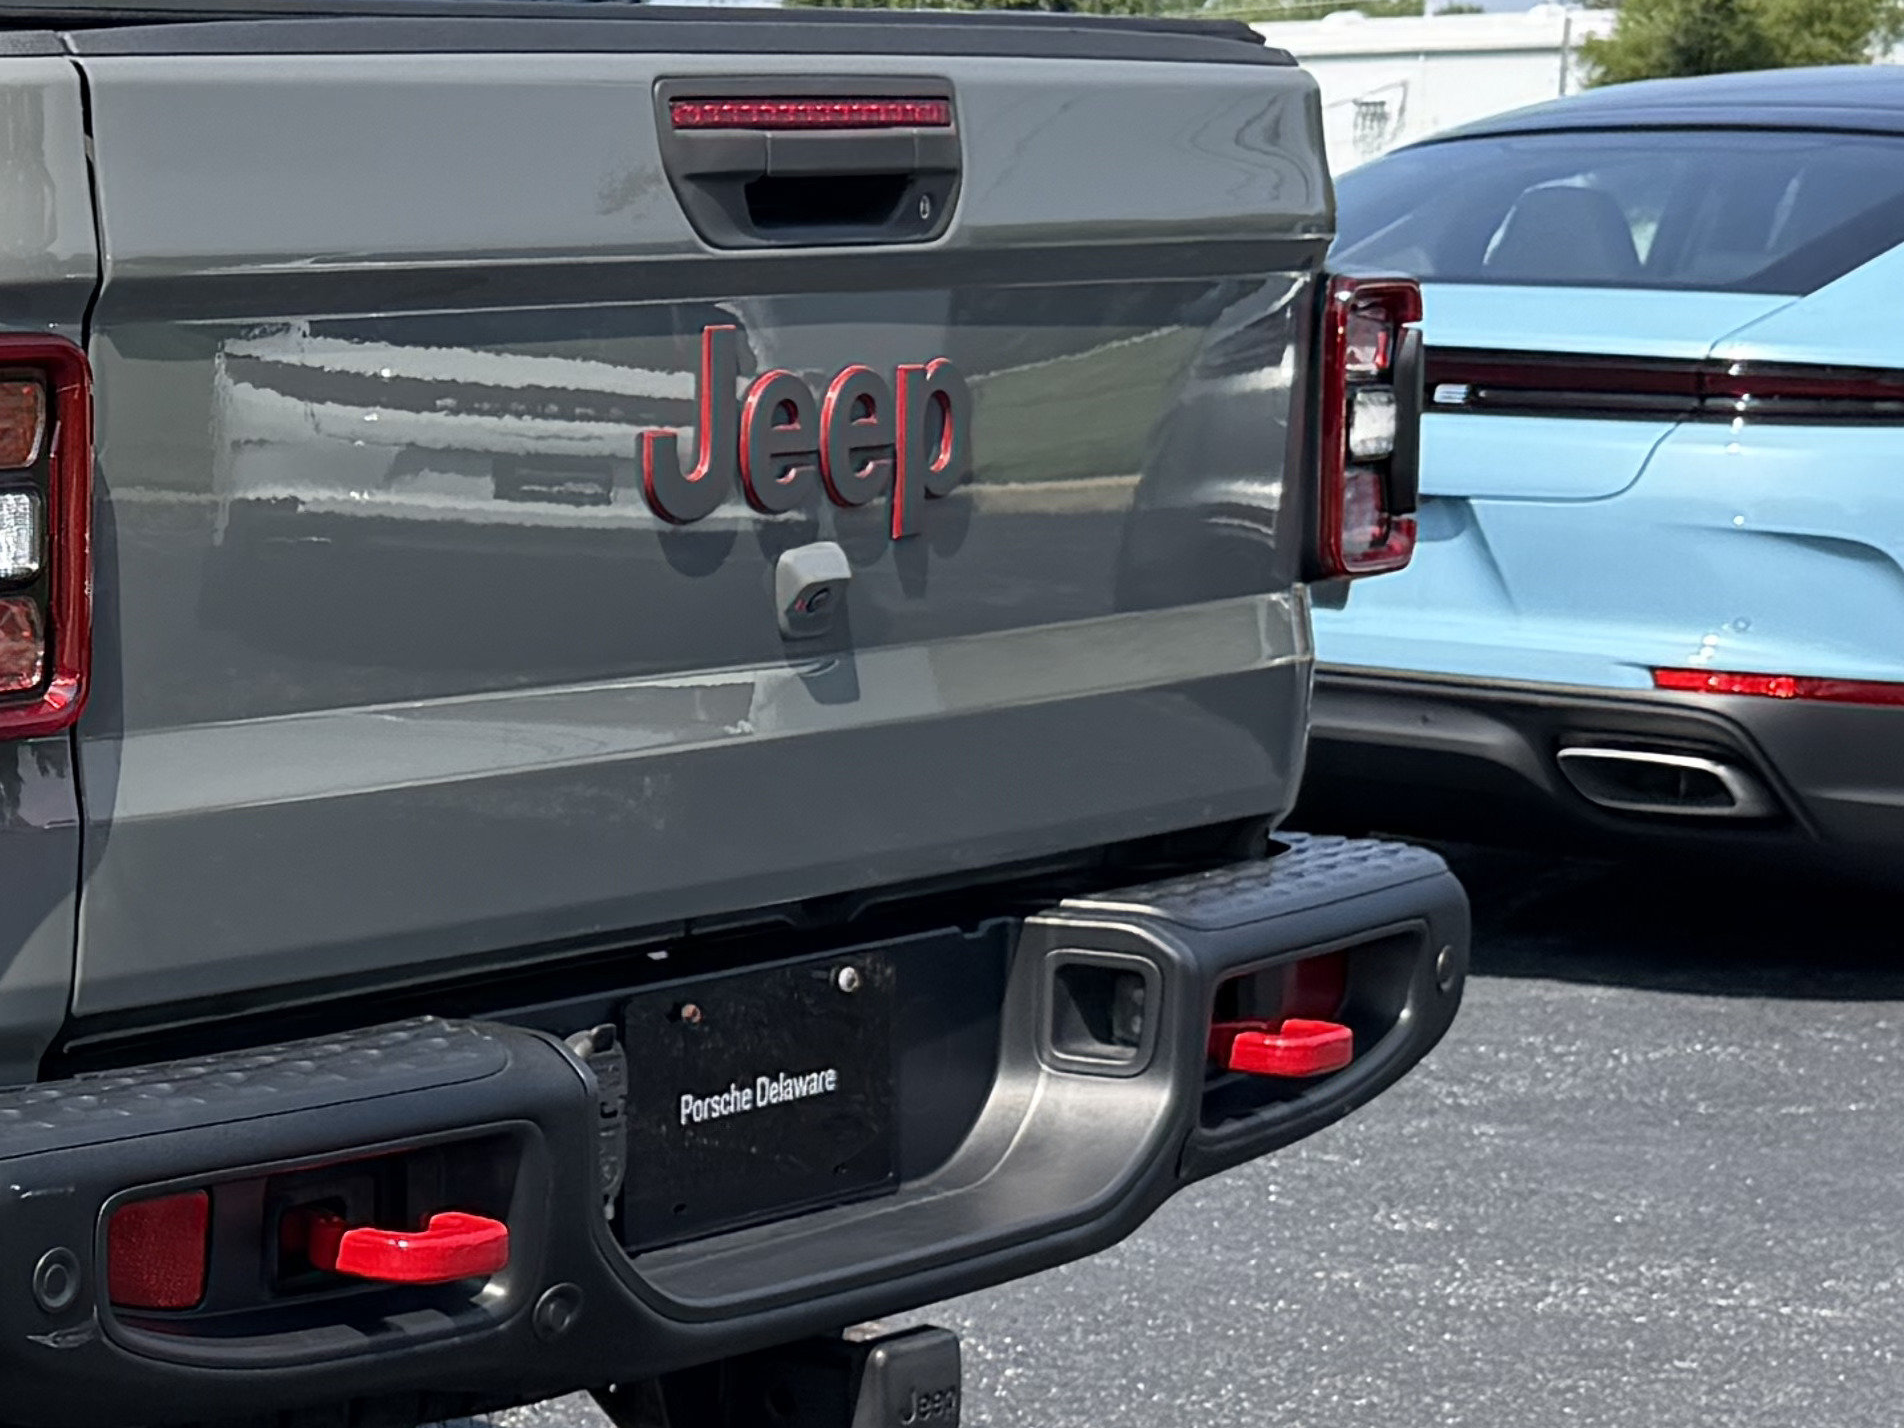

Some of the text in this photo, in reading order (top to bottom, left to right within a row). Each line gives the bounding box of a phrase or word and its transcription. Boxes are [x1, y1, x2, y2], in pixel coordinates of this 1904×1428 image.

[637, 324, 971, 539] Jeep
[680, 1068, 838, 1125] Porsche Delaware
[900, 1387, 957, 1426] Jeep
